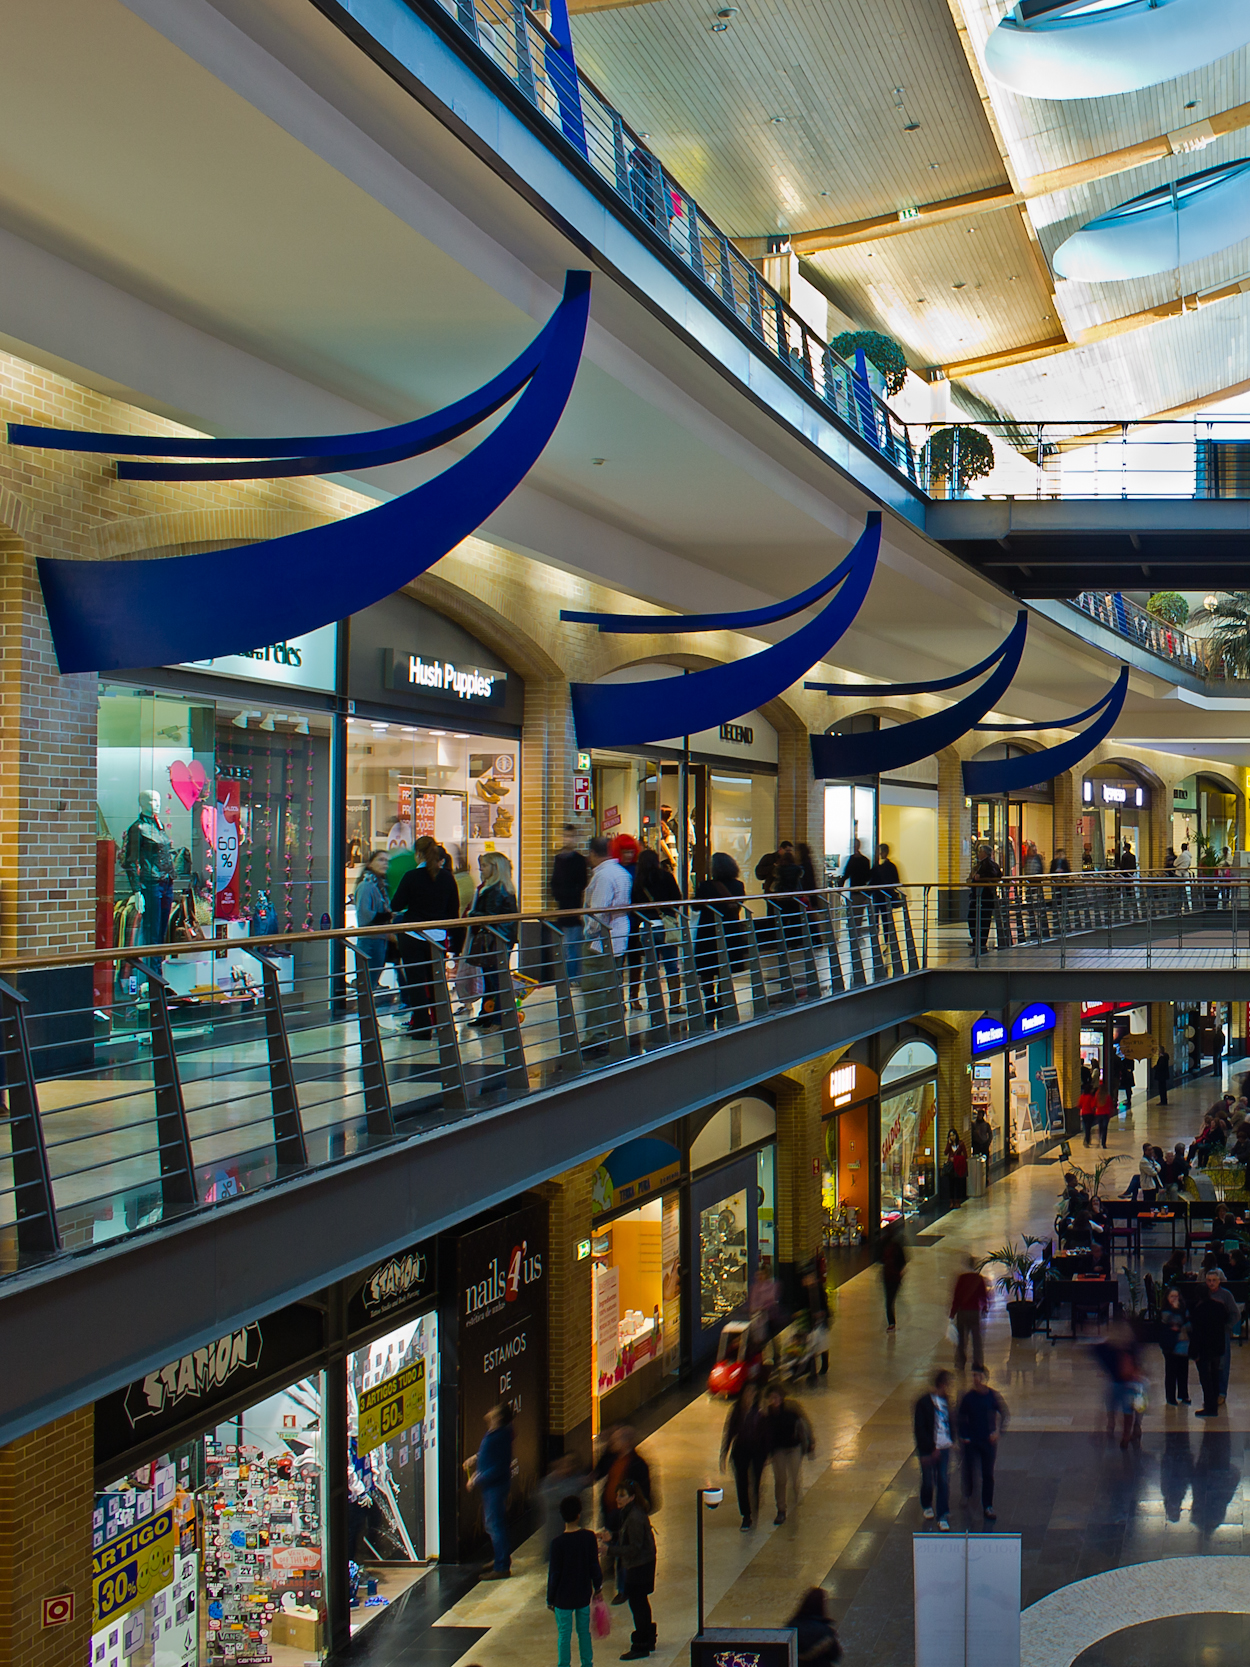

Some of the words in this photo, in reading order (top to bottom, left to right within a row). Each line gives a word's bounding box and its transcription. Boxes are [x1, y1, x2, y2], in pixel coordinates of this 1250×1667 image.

[408, 655, 443, 689] Hush
[218, 837, 236, 851] 60
[483, 1332, 527, 1373] ESTAMOS
[360, 1398, 366, 1411] 3
[366, 1379, 398, 1408] ARTIGOS
[399, 1368, 417, 1388] TUDO
[417, 1364, 423, 1376] A
[500, 1370, 512, 1394] DE
